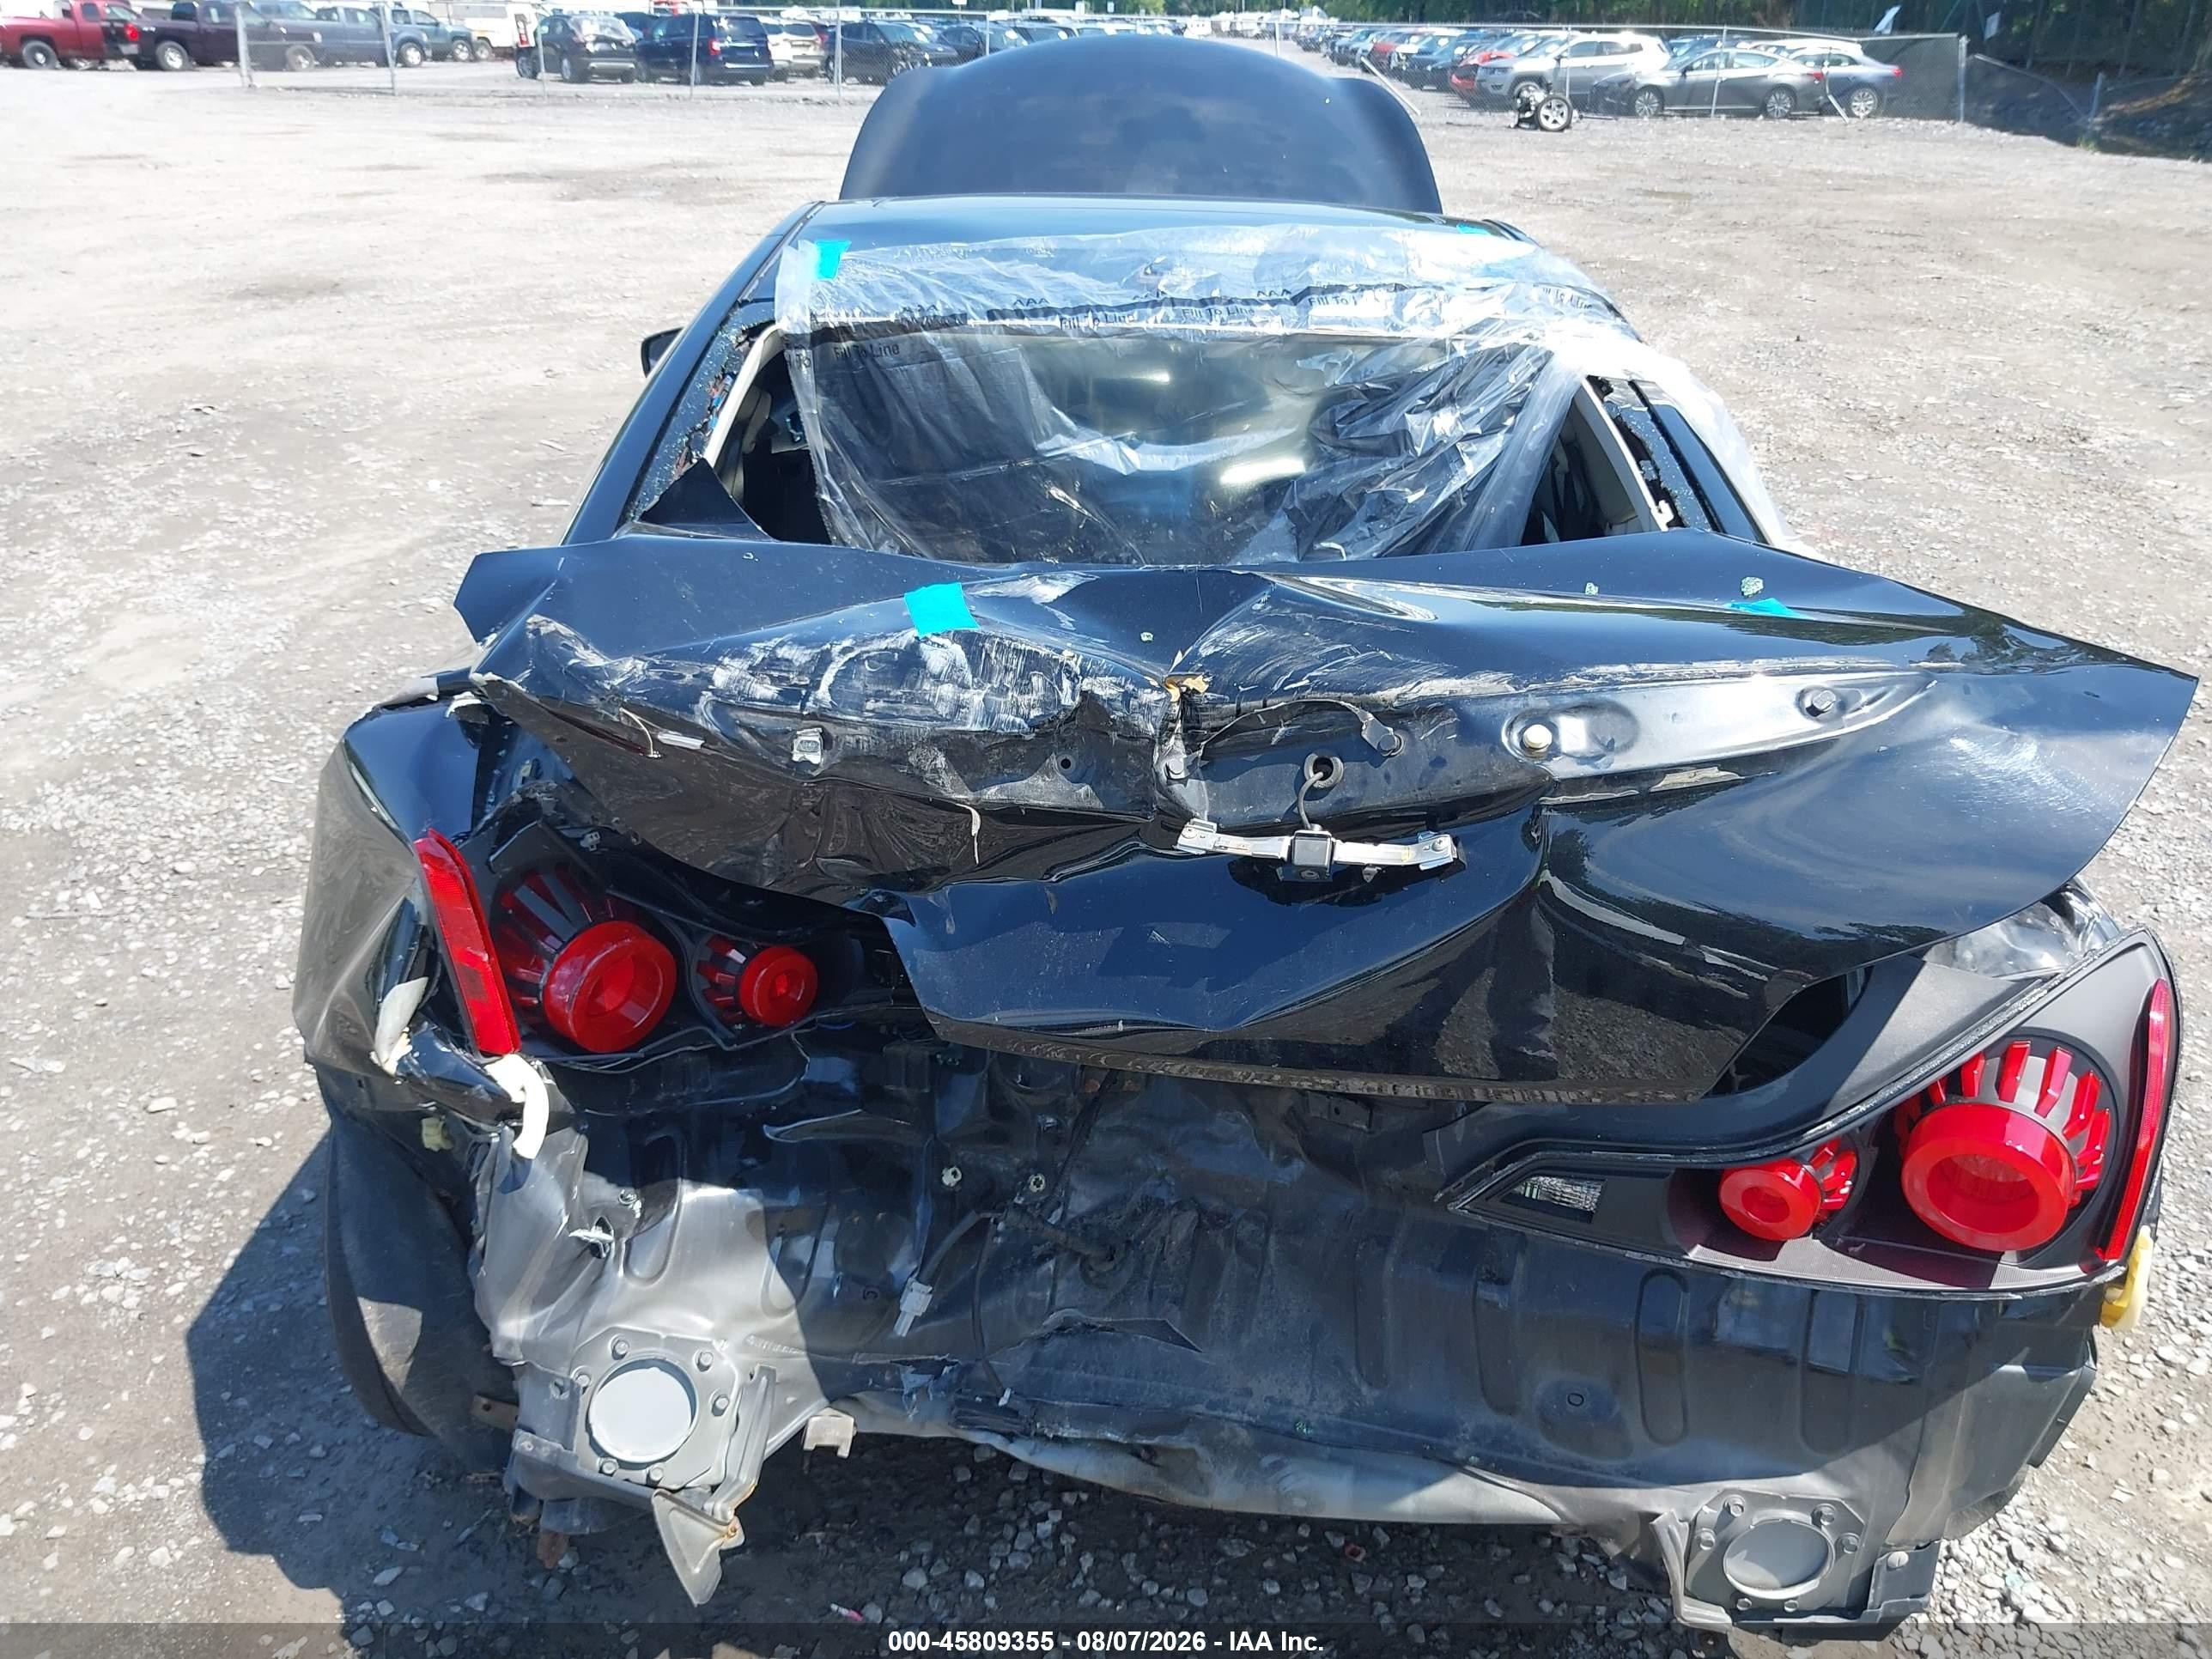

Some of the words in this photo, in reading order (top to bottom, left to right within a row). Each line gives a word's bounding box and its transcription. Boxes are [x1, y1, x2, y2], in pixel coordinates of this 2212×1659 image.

[1308, 296, 1328, 307] Fill
[1332, 295, 1349, 306] To
[1182, 307, 1203, 318] Fill
[1226, 306, 1255, 317] Line
[1059, 315, 1080, 330] Fill
[869, 343, 900, 358] Line
